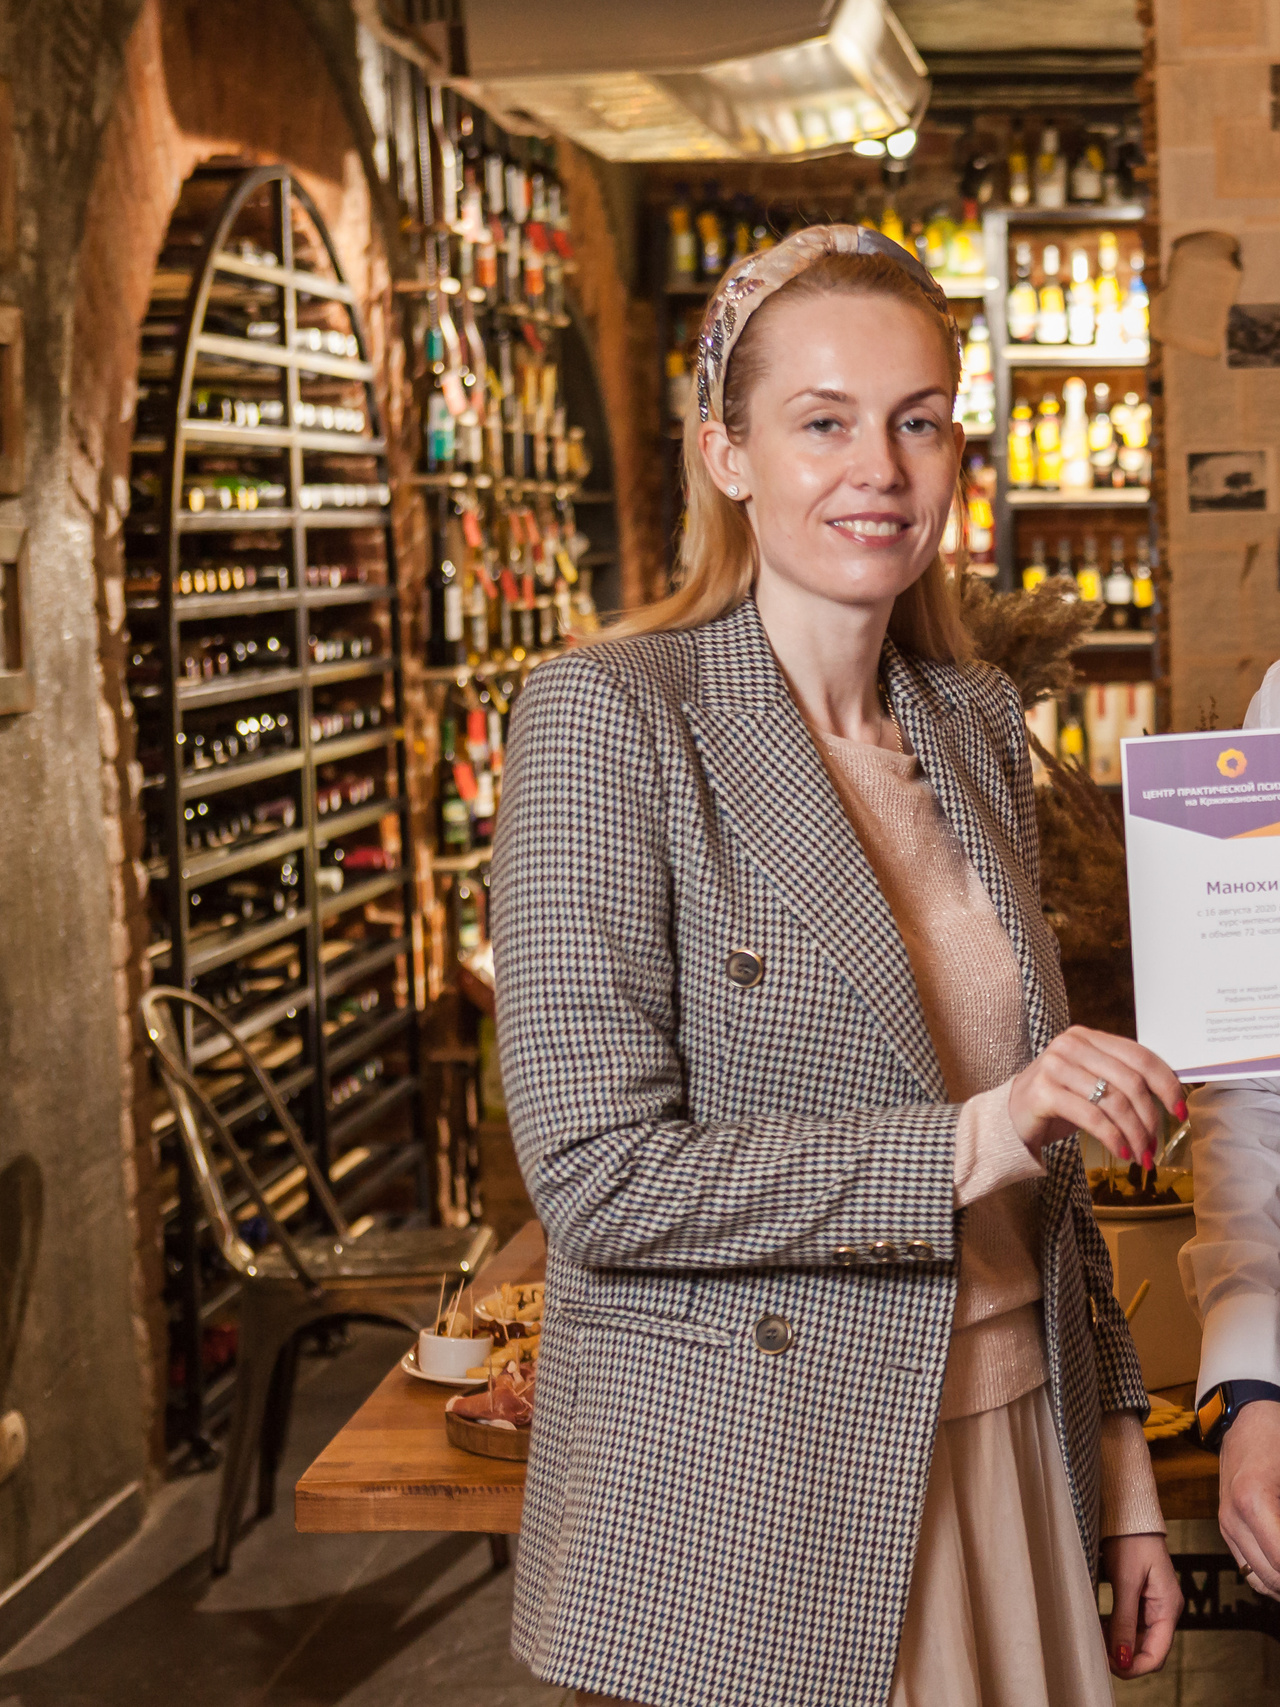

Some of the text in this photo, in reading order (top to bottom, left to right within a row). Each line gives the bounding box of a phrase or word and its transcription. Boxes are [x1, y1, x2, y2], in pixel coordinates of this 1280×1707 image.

[1142, 788, 1175, 800] ЦЕНТР
[1176, 781, 1254, 796] ПРАКТИЧЕСКОЙ
[1205, 908, 1215, 916] 16
[1254, 904, 1276, 913] 2020
[1244, 928, 1254, 936] 72
